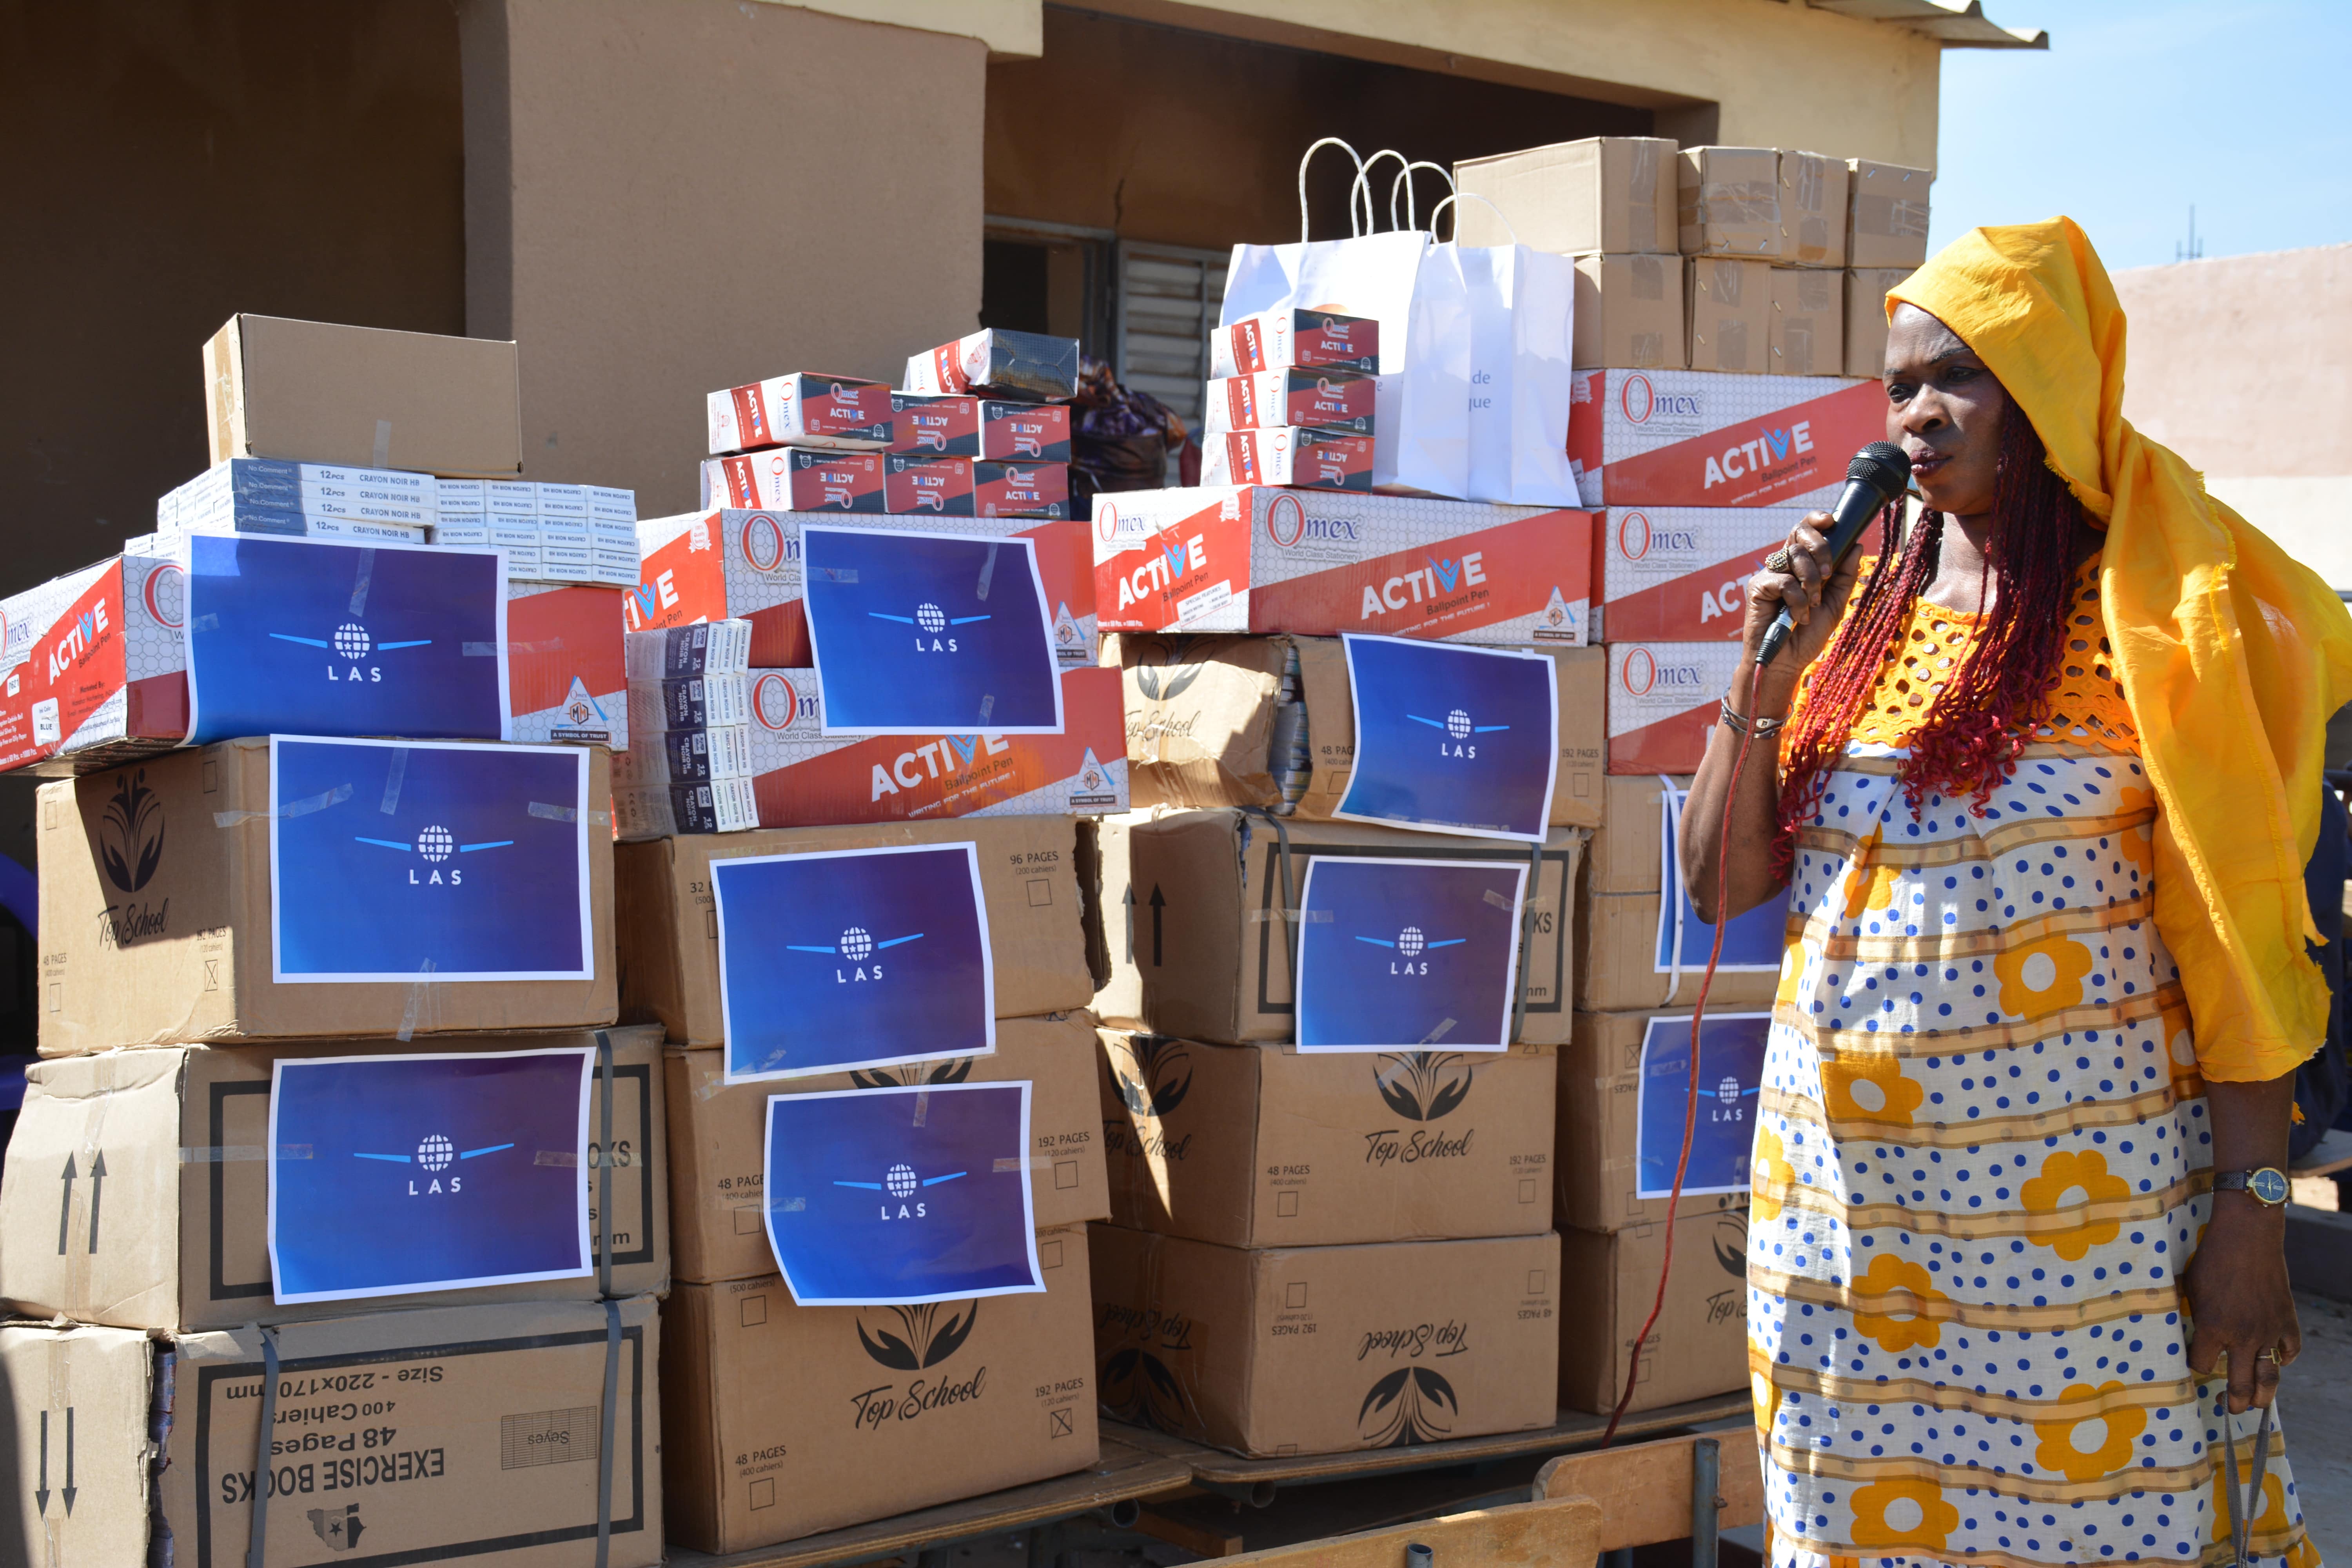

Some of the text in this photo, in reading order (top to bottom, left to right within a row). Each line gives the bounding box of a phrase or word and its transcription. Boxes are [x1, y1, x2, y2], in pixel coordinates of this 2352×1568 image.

[1245, 324, 1258, 368] ACTIVE
[1321, 341, 1354, 352] ACTIVE
[1472, 370, 1490, 384] de
[831, 383, 858, 401] Omex
[1622, 375, 1700, 423] Omex
[780, 382, 794, 428] Omex
[1315, 401, 1348, 413] ACTIVE
[747, 390, 762, 438] ACTIVE
[830, 408, 865, 420] ACTIVE
[912, 416, 948, 426] ACTIVE
[1011, 423, 1042, 433] ACTIVE
[1275, 434, 1287, 476] Omex
[1317, 451, 1347, 462] ACTIVE
[1704, 421, 1814, 489] ACTIVE
[820, 472, 854, 483] ACTIVE
[1006, 467, 1034, 484] Omex
[1761, 456, 1817, 483] Ballpoint Pen
[359, 475, 388, 483] CRAYON
[736, 461, 753, 509] ACTIVE
[912, 476, 944, 486] ACTIVE
[1759, 486, 1772, 495] FOR
[1788, 472, 1811, 484] FUTURE
[825, 492, 853, 509] Omex
[1006, 491, 1040, 501] ACTIVE
[361, 508, 389, 517] CRAYON
[391, 510, 409, 518] NOIR
[1268, 495, 1358, 546] Omex
[1100, 502, 1145, 542] Omex
[353, 526, 380, 535] CRAYON
[382, 529, 399, 537] NOIR
[1619, 512, 1695, 560] Omex
[1325, 551, 1358, 561] Stationery
[766, 573, 786, 581] World
[1119, 534, 1207, 611] ACTIVE
[1163, 572, 1208, 602] Ballpoint Pen
[1361, 552, 1486, 619] ACTIVE
[1185, 595, 1201, 606] SPECIAL
[1426, 590, 1489, 615] Ballpoint Pen
[667, 609, 682, 624] Pen
[1424, 619, 1437, 627] FOR
[1457, 604, 1483, 617] FUTURE
[49, 598, 109, 686] ACTIVE
[78, 633, 111, 668] Ballpoint Pen
[916, 639, 957, 652] LAS
[328, 666, 381, 682] LAS
[1623, 648, 1701, 695] Omex
[1442, 744, 1475, 758] LAS
[1562, 749, 1599, 758] 192 PAGES
[872, 735, 1009, 802] ACTIVE
[945, 757, 1013, 791] Ballpoint Pen
[909, 774, 1010, 818] WRITING FOR THE FUTURE
[1010, 851, 1058, 864] 96 PAGES
[410, 868, 461, 885] LAS
[1031, 865, 1057, 873] cahiers)
[690, 882, 704, 893] 32
[98, 898, 169, 950] Top School
[196, 926, 226, 940] 192 PAGES
[44, 953, 67, 965] 48 PAGES
[837, 965, 882, 983] LAS
[1391, 962, 1427, 975] LAS
[1713, 1109, 1742, 1121] LAS
[1038, 1132, 1090, 1147] 192 PAGES
[1103, 1120, 1192, 1161] Top School
[1365, 1129, 1474, 1167] Top School
[1268, 1165, 1310, 1176] 48 PAGES
[409, 1177, 461, 1195] LAS
[718, 1174, 764, 1189] 48 PAGE
[882, 1203, 926, 1220] LAS
[1706, 1289, 1735, 1325] Top
[1272, 1324, 1317, 1335] 192 PAGES
[1357, 1319, 1468, 1360] Top School
[398, 1366, 444, 1382] Size
[280, 1373, 376, 1398] 220x170
[1035, 1378, 1083, 1397] 192 PAGES
[851, 1367, 986, 1430] Top School
[362, 1401, 396, 1416] 400
[271, 1427, 397, 1455] 48 Pages
[528, 1430, 569, 1445] Seyes
[735, 1445, 786, 1466] 48 PAGES
[323, 1447, 445, 1490] EXERCISE
[756, 1460, 783, 1473] cahiers)
